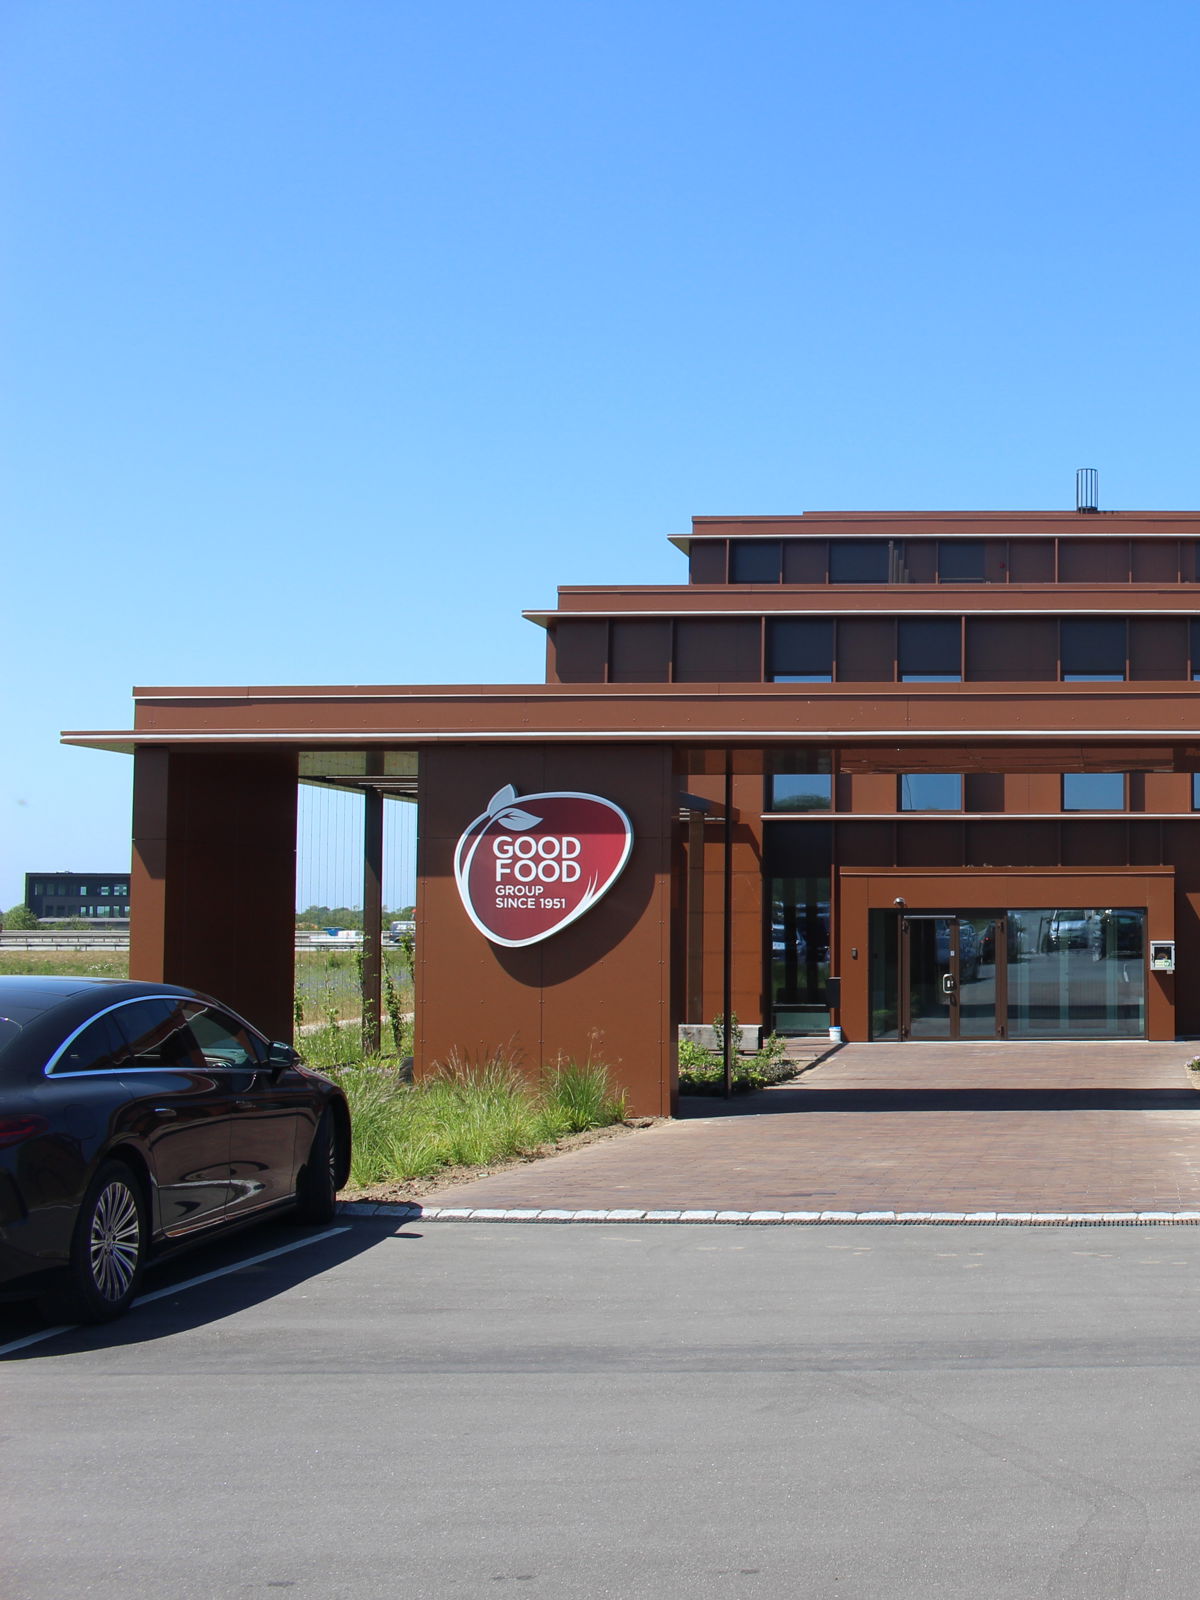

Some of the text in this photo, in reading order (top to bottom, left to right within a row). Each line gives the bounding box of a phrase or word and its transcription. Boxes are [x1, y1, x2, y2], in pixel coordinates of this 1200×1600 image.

[492, 836, 581, 859] GOOD
[495, 859, 581, 883] FOOD
[495, 885, 544, 896] GROUP
[495, 897, 566, 909] SINCE 1951
